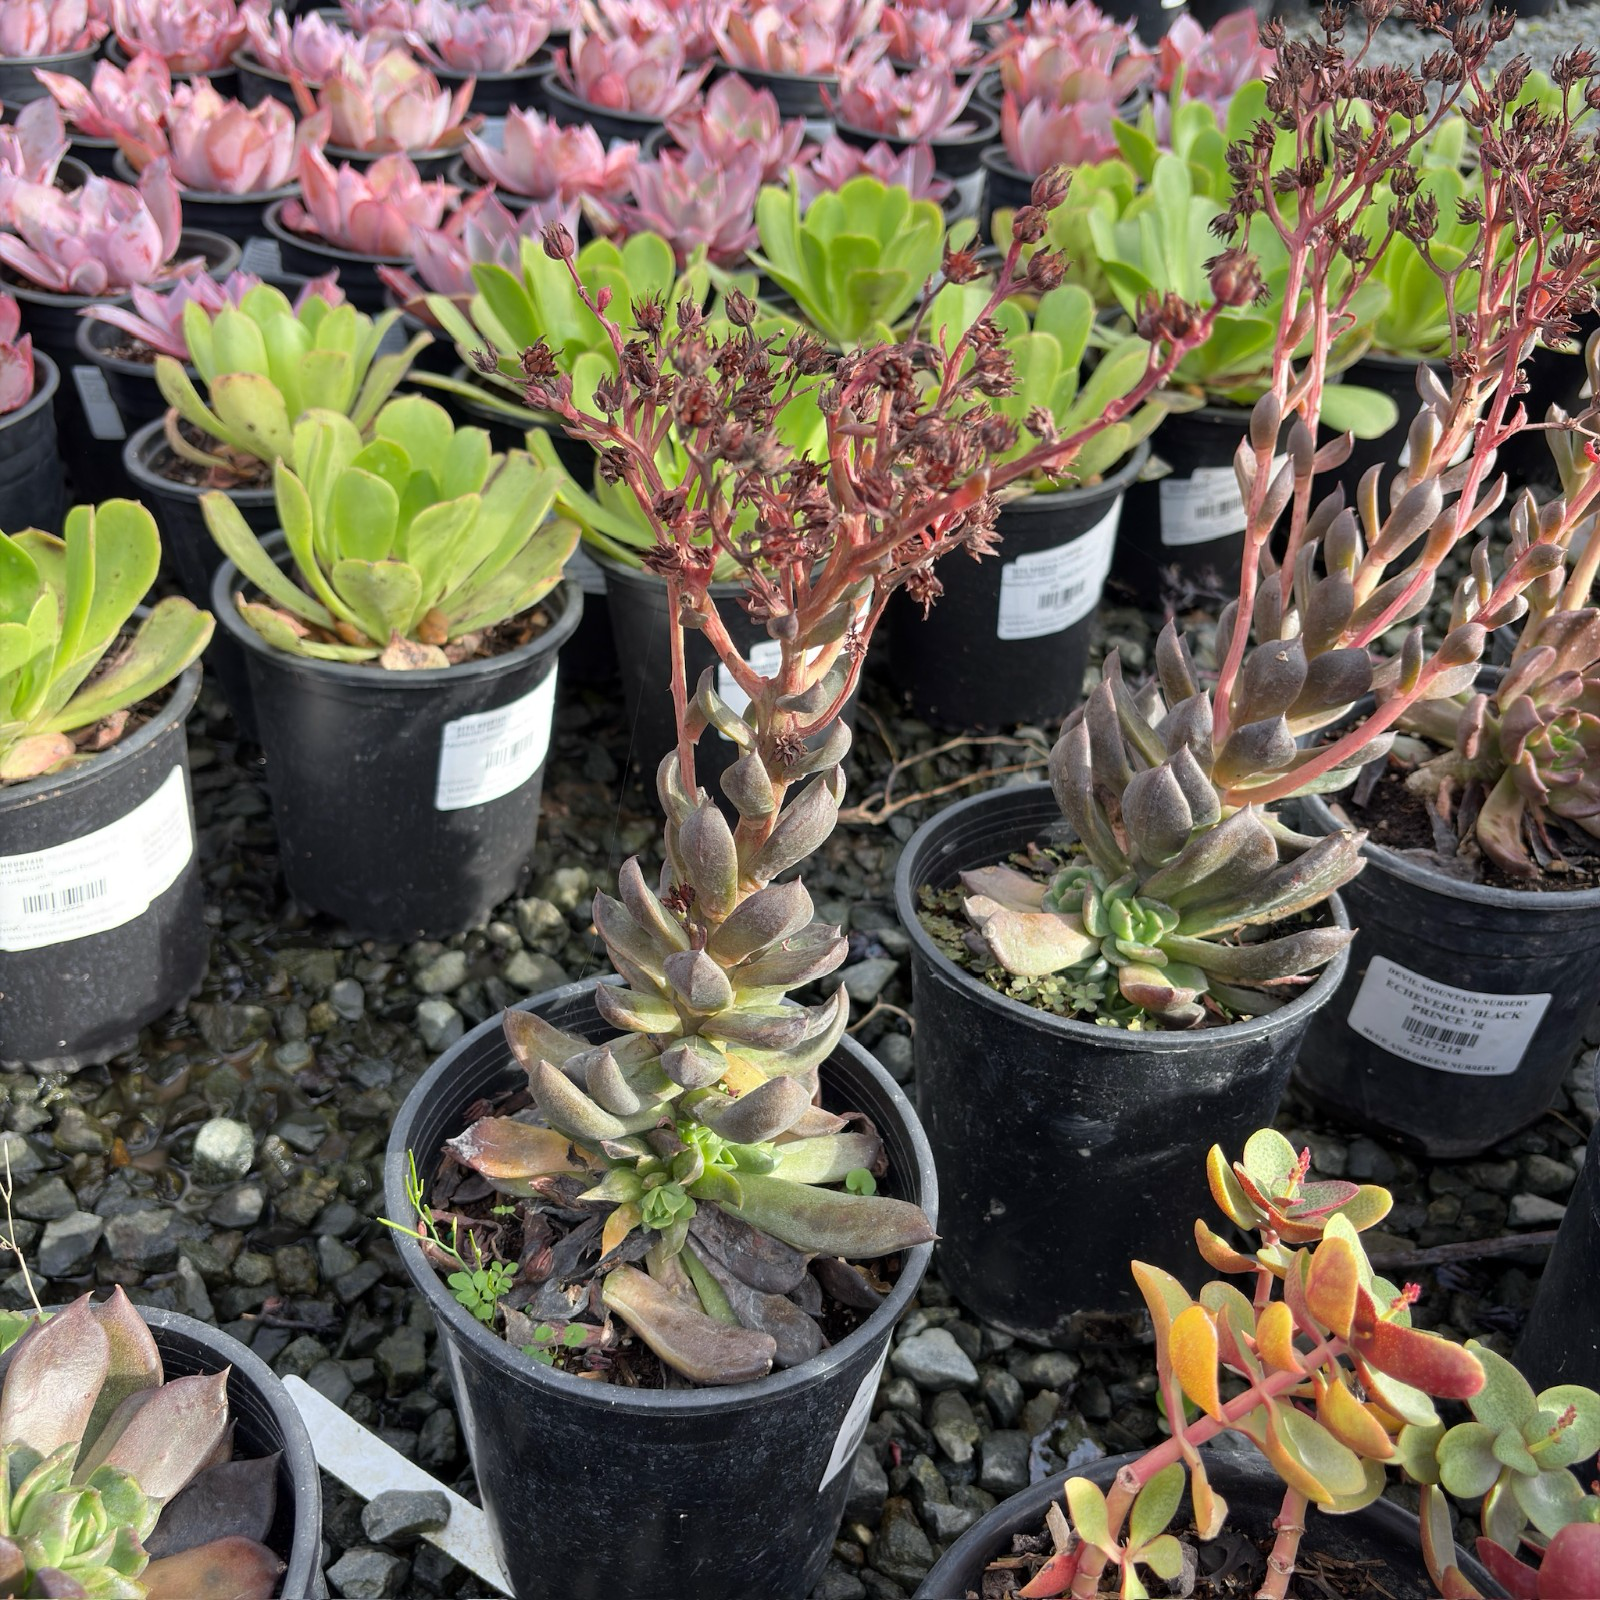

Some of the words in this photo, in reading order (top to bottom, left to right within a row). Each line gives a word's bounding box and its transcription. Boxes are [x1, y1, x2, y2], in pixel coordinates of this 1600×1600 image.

[1385, 979, 1466, 1015] ECHEVERIA
[1470, 1008, 1523, 1020] 'BLACK
[1387, 966, 1418, 988] DEVIL
[1420, 983, 1480, 1005] MOUNTAIN
[1482, 998, 1531, 1008] NURSERY
[1411, 1003, 1469, 1026] PRINCE'
[1389, 1043, 1411, 1057] AND
[1412, 1052, 1448, 1067] GREEN
